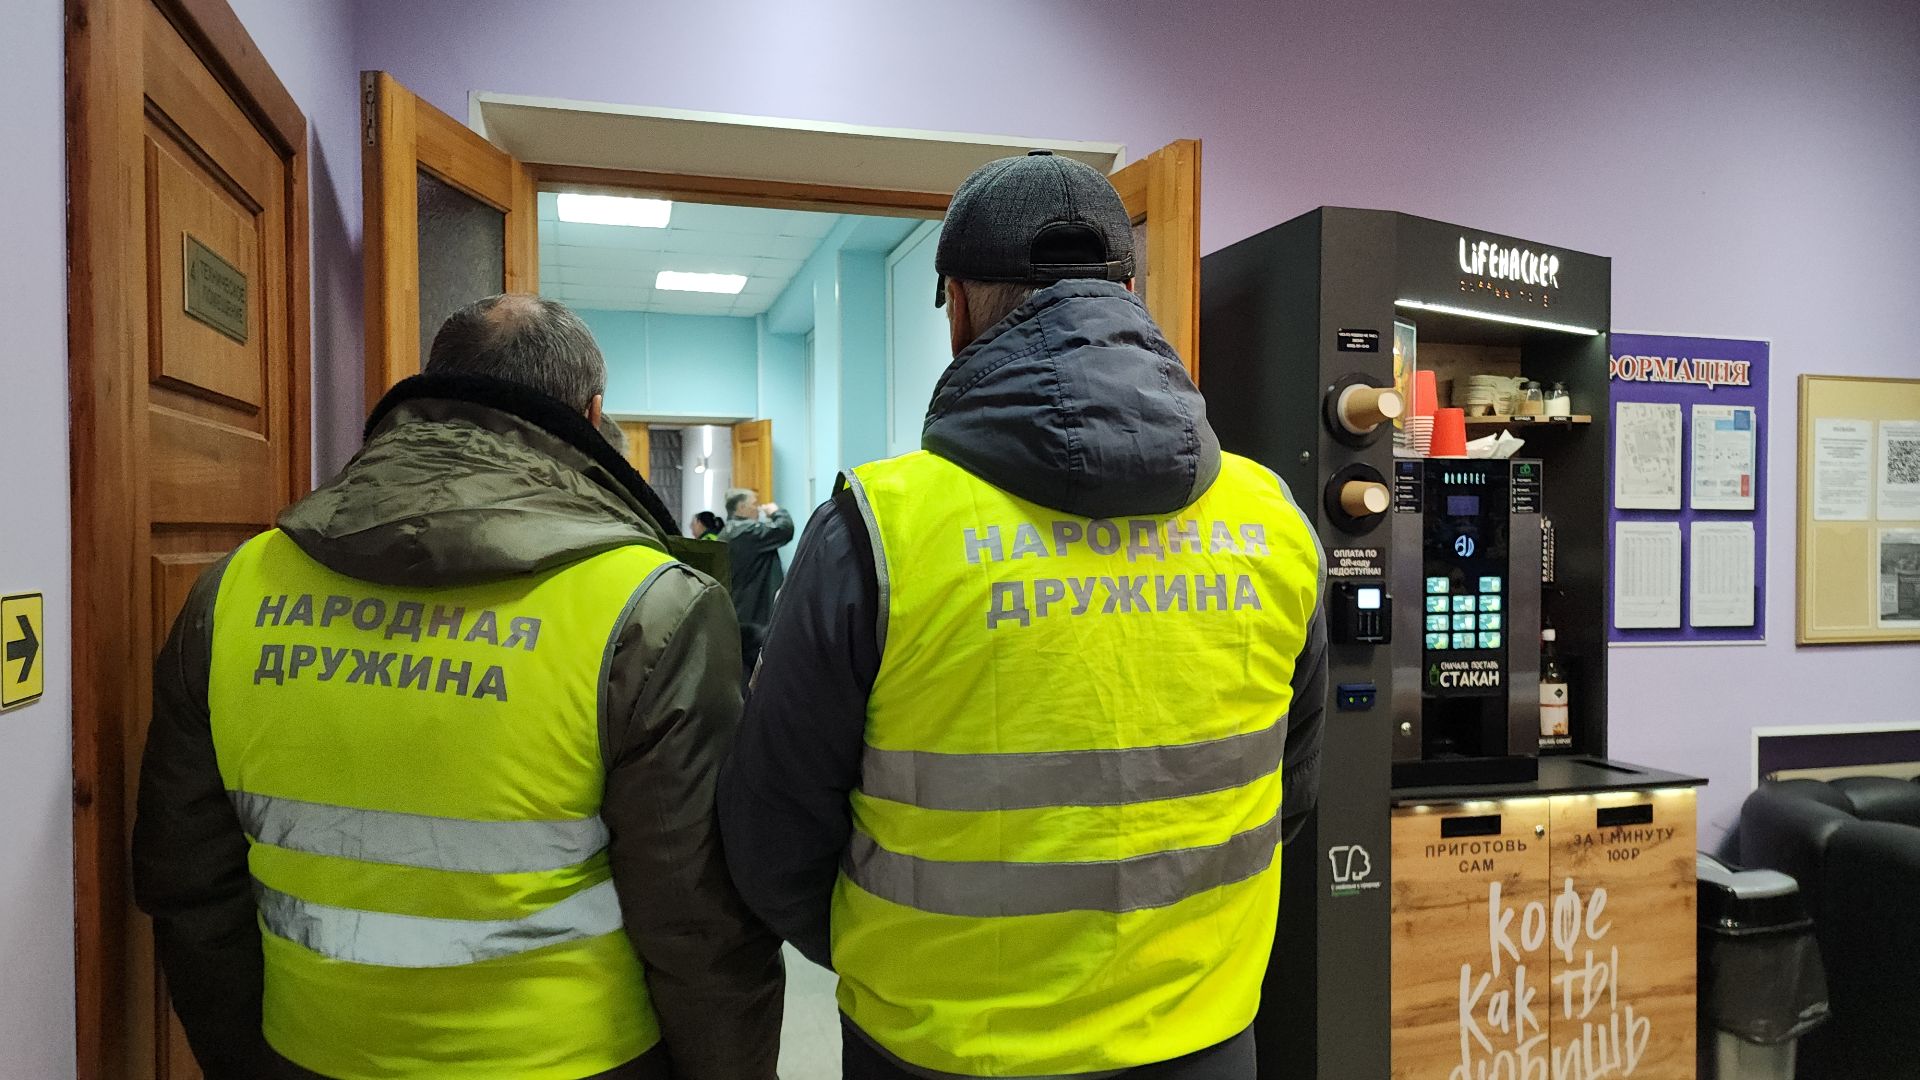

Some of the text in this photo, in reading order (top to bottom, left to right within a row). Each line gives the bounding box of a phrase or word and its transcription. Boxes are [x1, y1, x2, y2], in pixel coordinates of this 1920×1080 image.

[963, 518, 1271, 564] НАРОДНАЯ
[1333, 549, 1378, 558] ОПЛАТА ПО
[986, 574, 1262, 630] ДРУЖИНА
[254, 594, 542, 652] НАРОДНАЯ
[253, 644, 509, 703] ДРУЖИНА
[1439, 670, 1500, 688] СТАКАН
[1574, 833, 1594, 847] ЗА
[1609, 827, 1675, 844] МИНУТУ
[1425, 839, 1527, 859] ПРИГОТОВЬ
[1458, 859, 1495, 874] САМ
